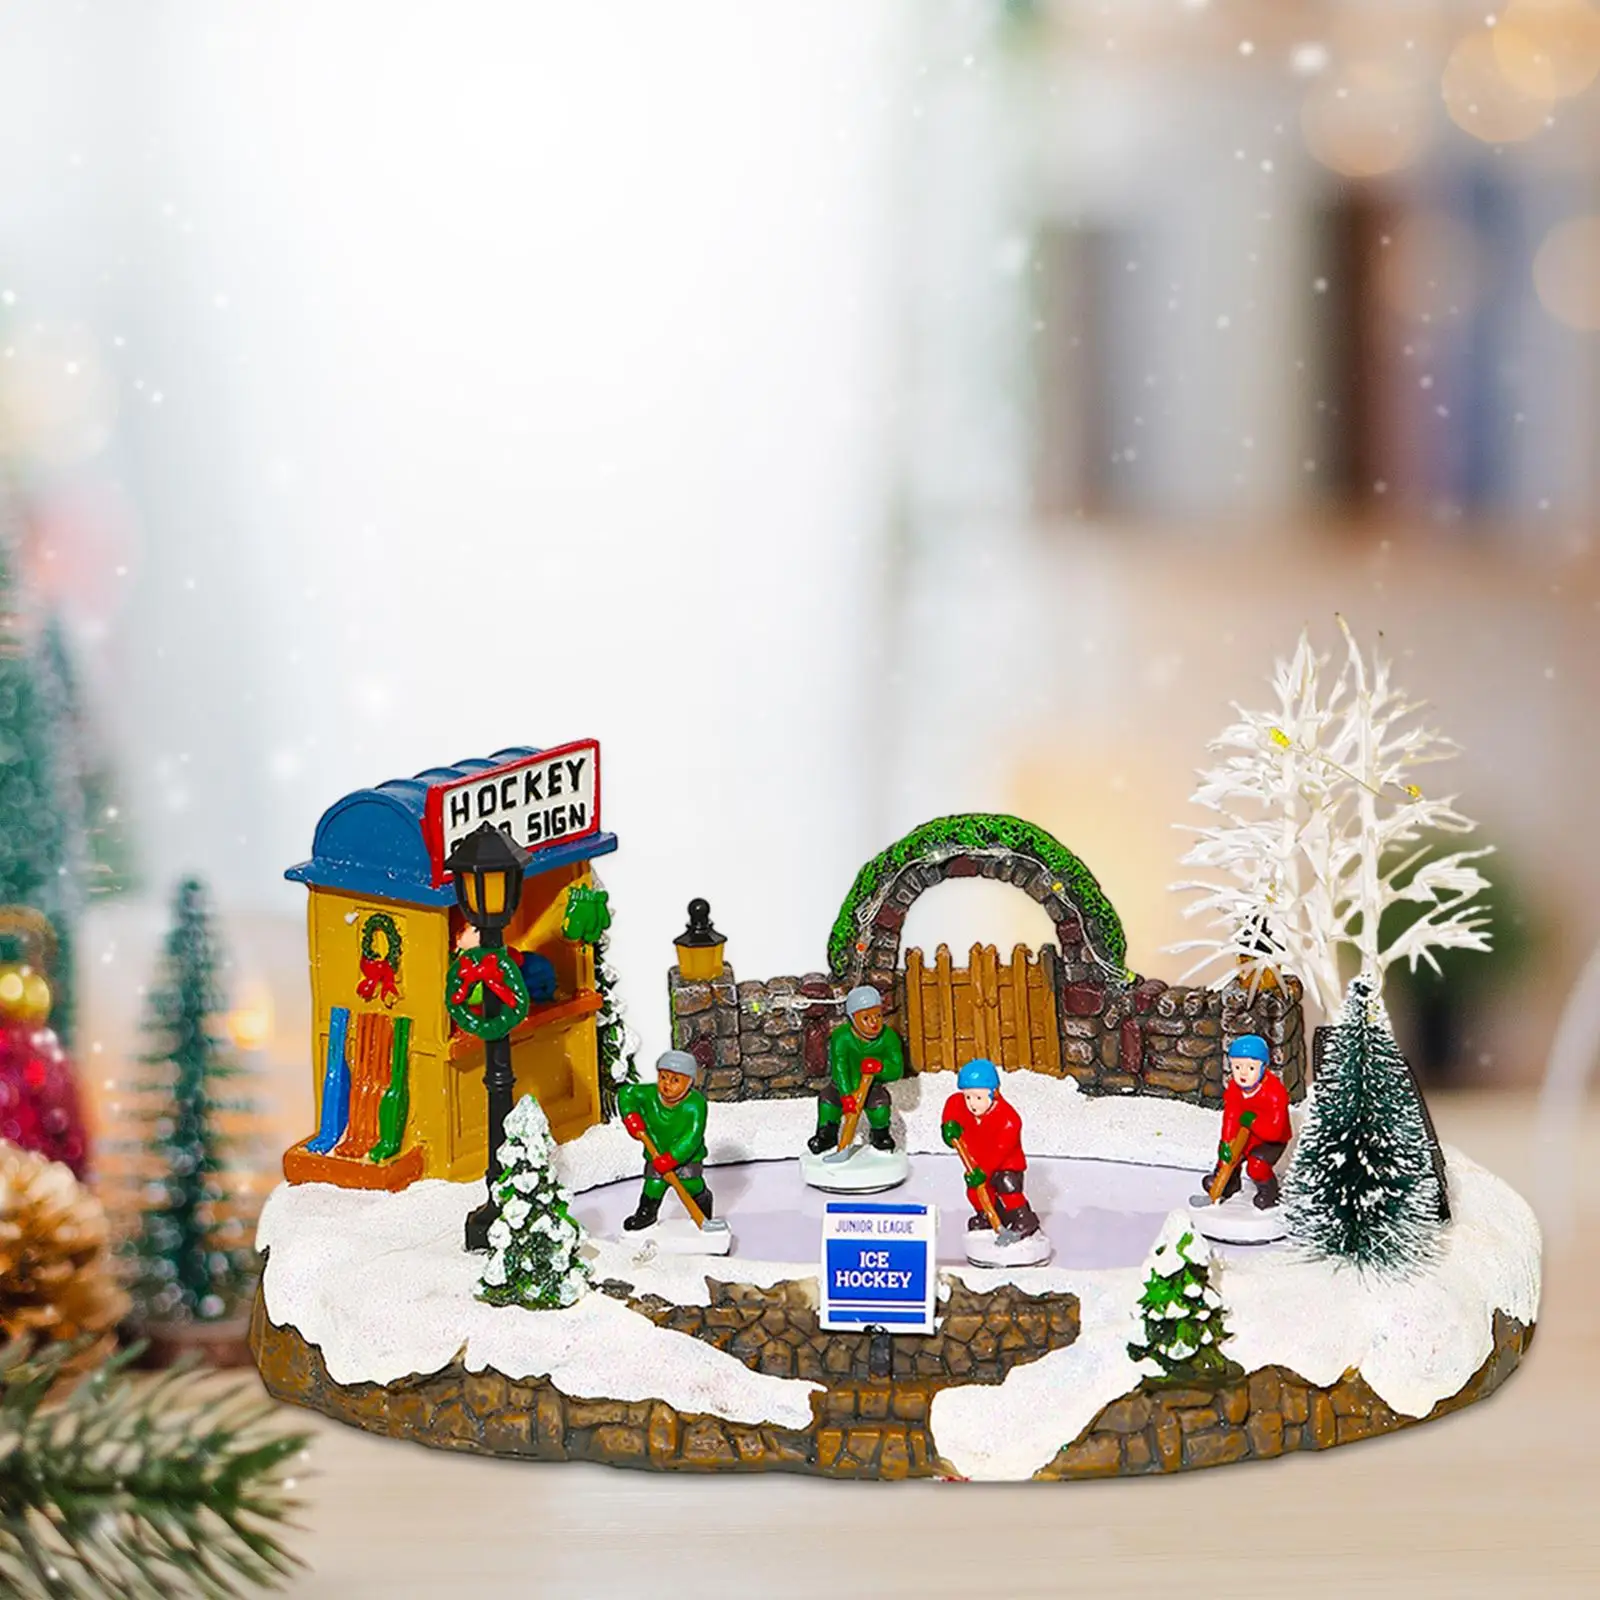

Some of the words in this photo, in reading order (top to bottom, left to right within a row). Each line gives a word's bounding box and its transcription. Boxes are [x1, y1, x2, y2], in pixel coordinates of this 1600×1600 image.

[450, 757, 586, 829] HOCKEY
[527, 802, 586, 843] SIGN
[835, 1219, 873, 1233] JUNIOR
[877, 1220, 915, 1234] LEAGUE
[859, 1251, 889, 1268] ICE
[835, 1270, 912, 1288] HOCKEY
